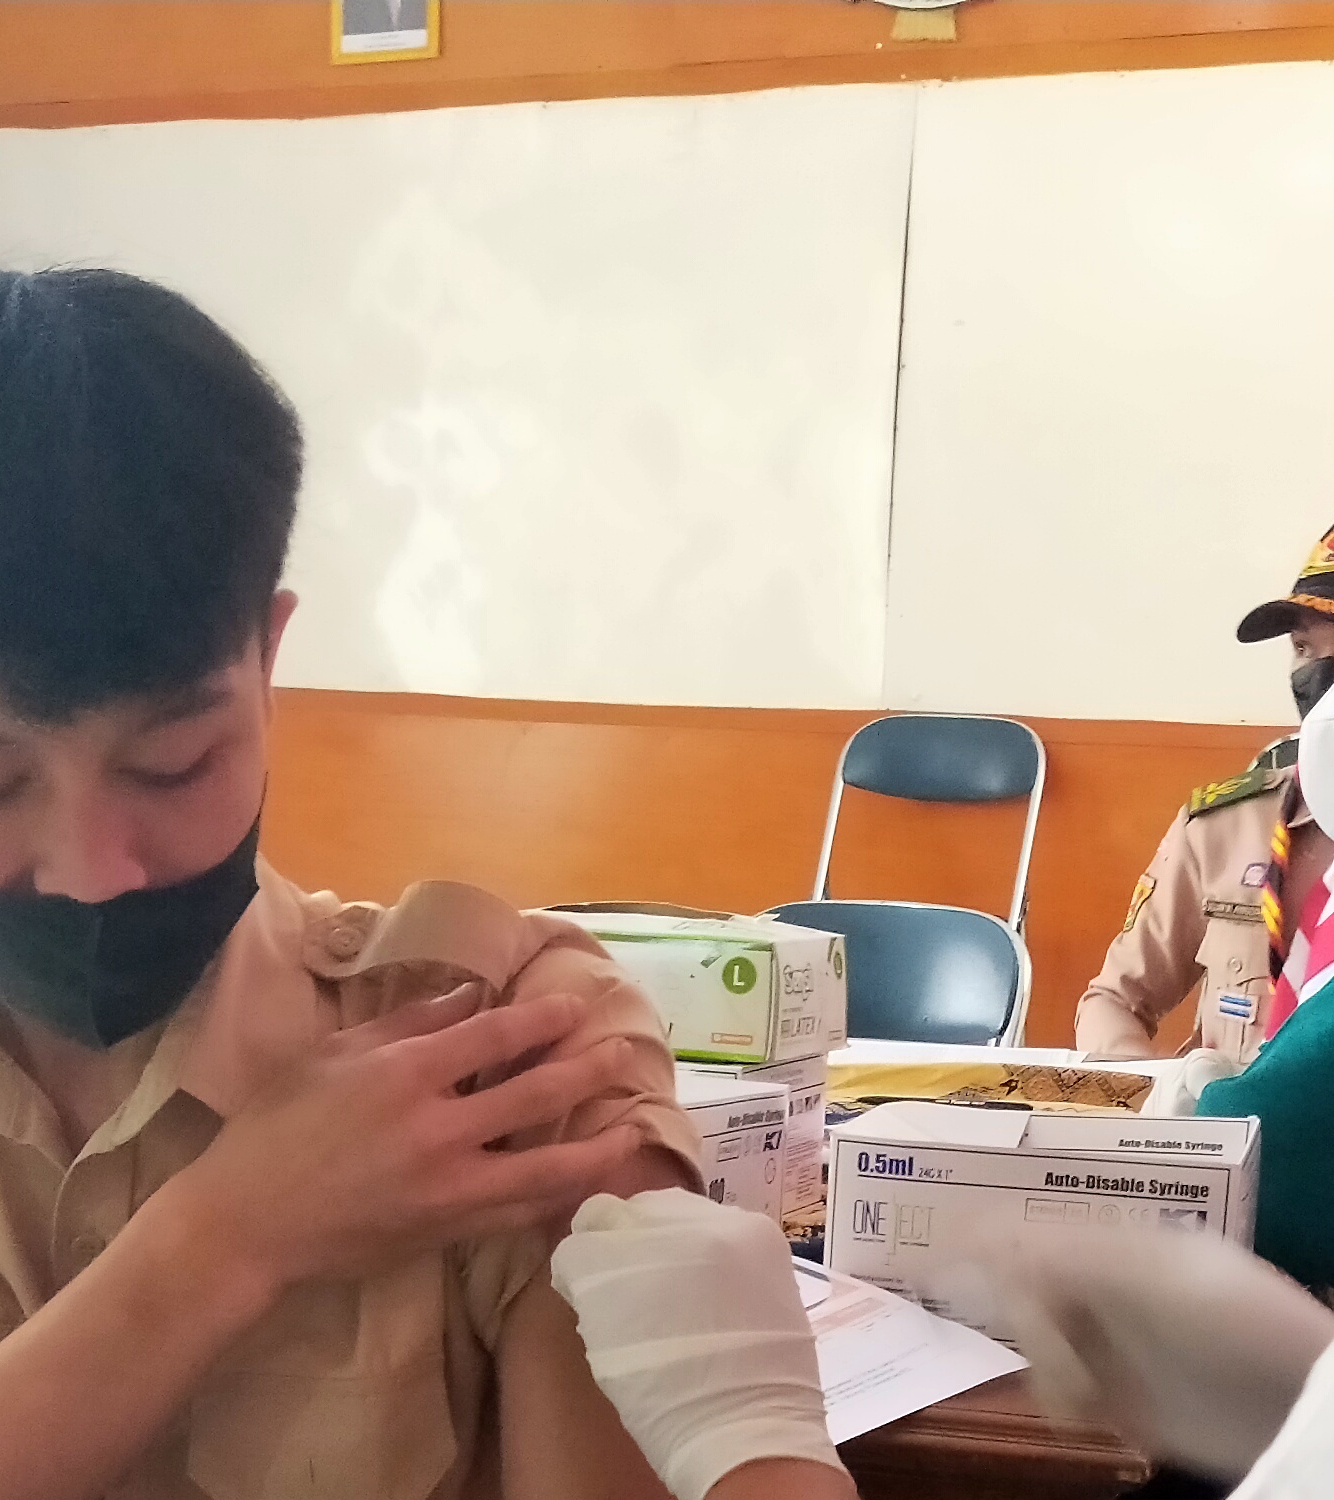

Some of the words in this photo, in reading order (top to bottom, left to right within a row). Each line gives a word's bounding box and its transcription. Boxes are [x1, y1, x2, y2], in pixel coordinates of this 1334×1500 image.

[732, 965, 745, 987] L
[1118, 1139, 1182, 1149] Auto-Disable
[1184, 1141, 1223, 1151] Syringe
[857, 1151, 914, 1176] 0.5ml
[1044, 1171, 1145, 1193] Auto-Disable
[1148, 1179, 1210, 1199] Syringe
